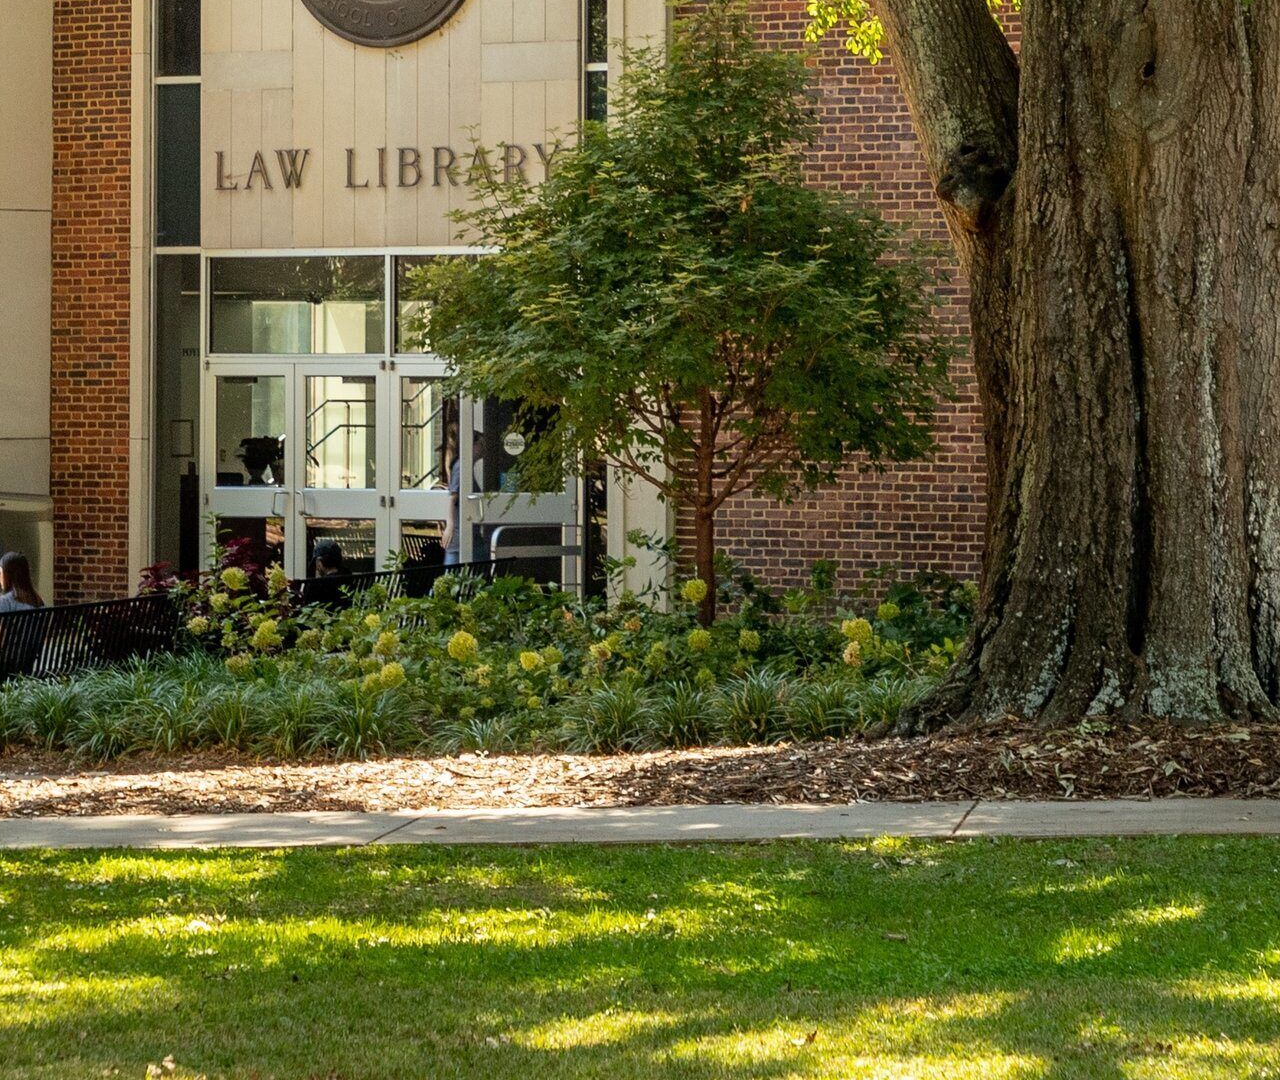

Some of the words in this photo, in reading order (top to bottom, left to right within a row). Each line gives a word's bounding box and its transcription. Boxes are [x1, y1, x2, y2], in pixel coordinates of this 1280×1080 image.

[386, 6, 408, 27] OF
[214, 148, 312, 191] LAW
[344, 143, 560, 189] LIBRARY
